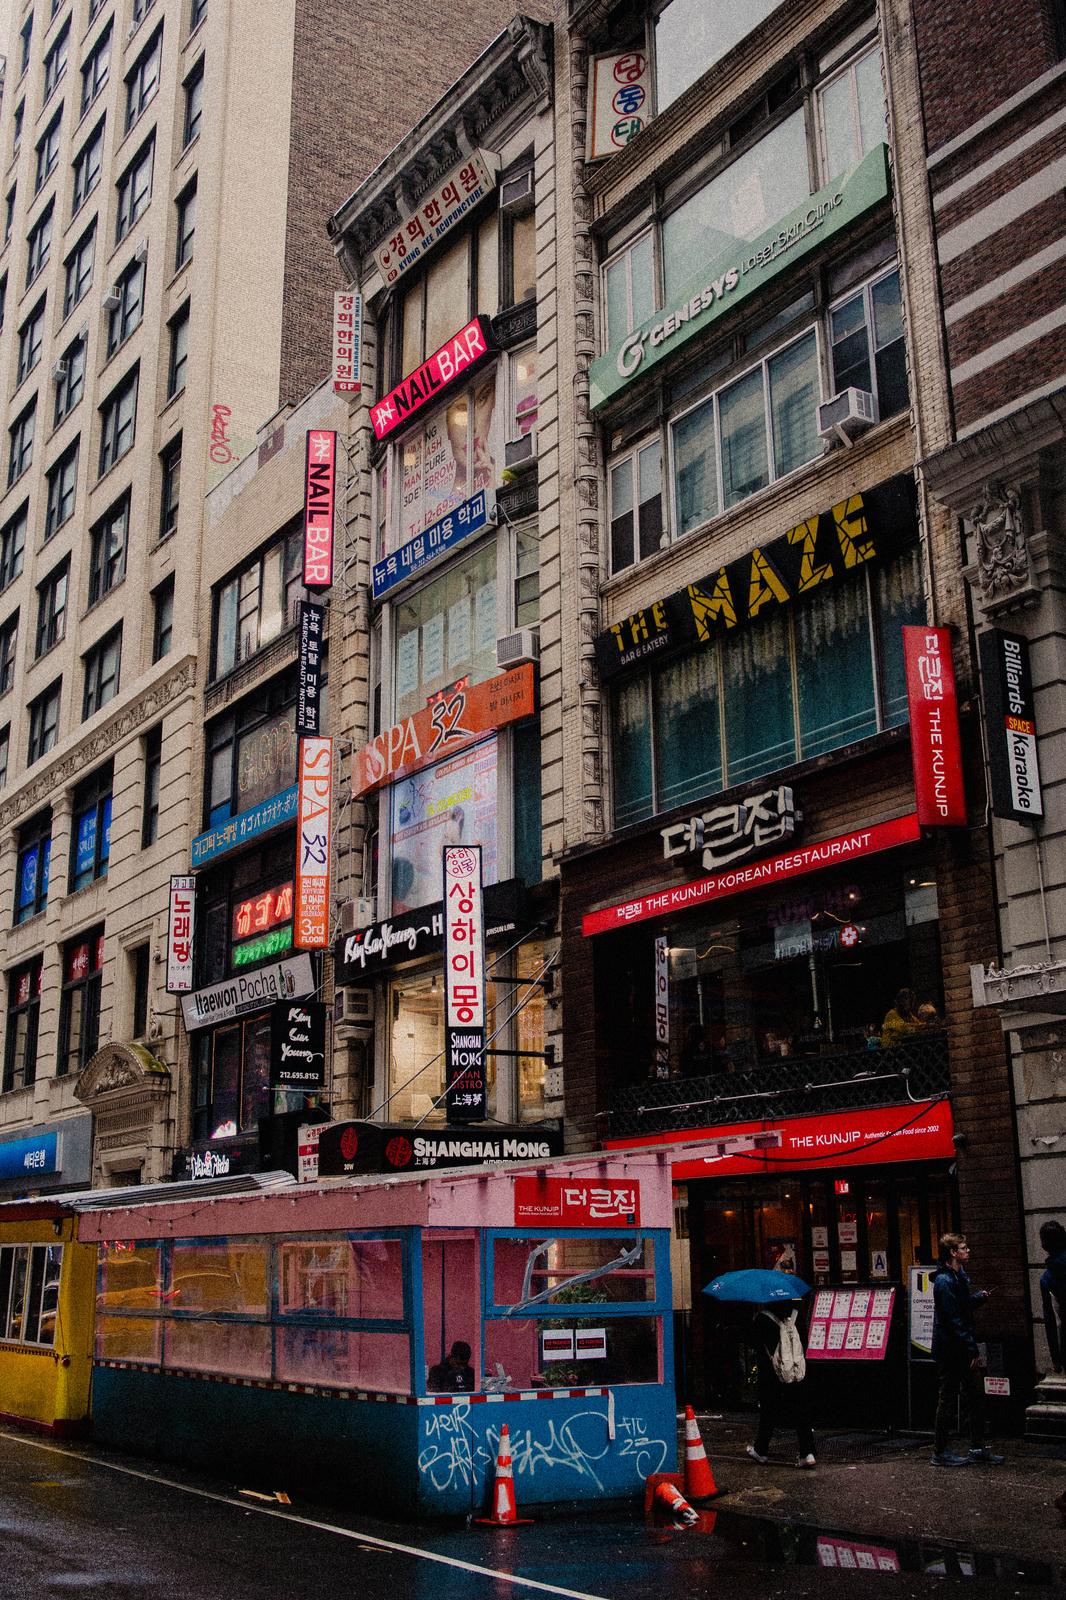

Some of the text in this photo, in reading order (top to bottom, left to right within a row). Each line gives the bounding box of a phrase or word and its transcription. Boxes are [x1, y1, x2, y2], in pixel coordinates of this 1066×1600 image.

[389, 162, 480, 258] 경희한의원
[398, 186, 484, 271] KYUNG HEE ACUPUNCTURE
[740, 239, 776, 276] Laser
[775, 220, 804, 249] Skin
[805, 192, 843, 232] Clinic
[337, 295, 353, 380] 경희한의원
[649, 266, 740, 347] GENESYS
[339, 382, 355, 391] 6F
[392, 366, 442, 418] NAIL
[436, 325, 485, 382] BAR
[308, 463, 331, 524] NAIL
[305, 525, 330, 583] BAR
[374, 557, 398, 586] 뉴욕
[401, 536, 425, 566] 네일
[429, 517, 455, 547] 미용
[457, 493, 485, 525] 학교
[610, 600, 669, 652] THE
[688, 494, 876, 642] MAZE
[298, 612, 309, 726] AMERICAN BEAUTY INSTITUTE
[620, 650, 638, 666] BAR
[642, 634, 669, 657] EATERY
[918, 633, 943, 701] 더큰집
[1003, 639, 1023, 715] Billiards
[366, 716, 424, 785] SPA
[427, 692, 474, 753] 32
[928, 707, 949, 817] THE KUNJIP
[1009, 719, 1031, 733] SPACE
[302, 738, 330, 823] SPA
[1012, 733, 1033, 809] Karaoke
[301, 831, 328, 870] 32
[660, 785, 795, 871] 더큰집
[616, 833, 872, 920] 더큰집 THE KUNJIP KOREAN RESTAURANT
[173, 893, 190, 963] 노래방
[301, 918, 325, 936] 3rd
[301, 935, 324, 943] FLOOR
[448, 881, 479, 1023] 상하이몽
[194, 984, 239, 1016] Itaewon
[238, 971, 278, 1001] Pocha
[451, 1049, 482, 1066] MONG
[789, 1131, 861, 1148] THE KUNJIP
[864, 1131, 886, 1140] Authentic
[902, 1127, 915, 1136] Food
[914, 1127, 927, 1135] since
[926, 1124, 940, 1133] 2002
[564, 1188, 636, 1218] 더큰집
[874, 1254, 885, 1270] A
